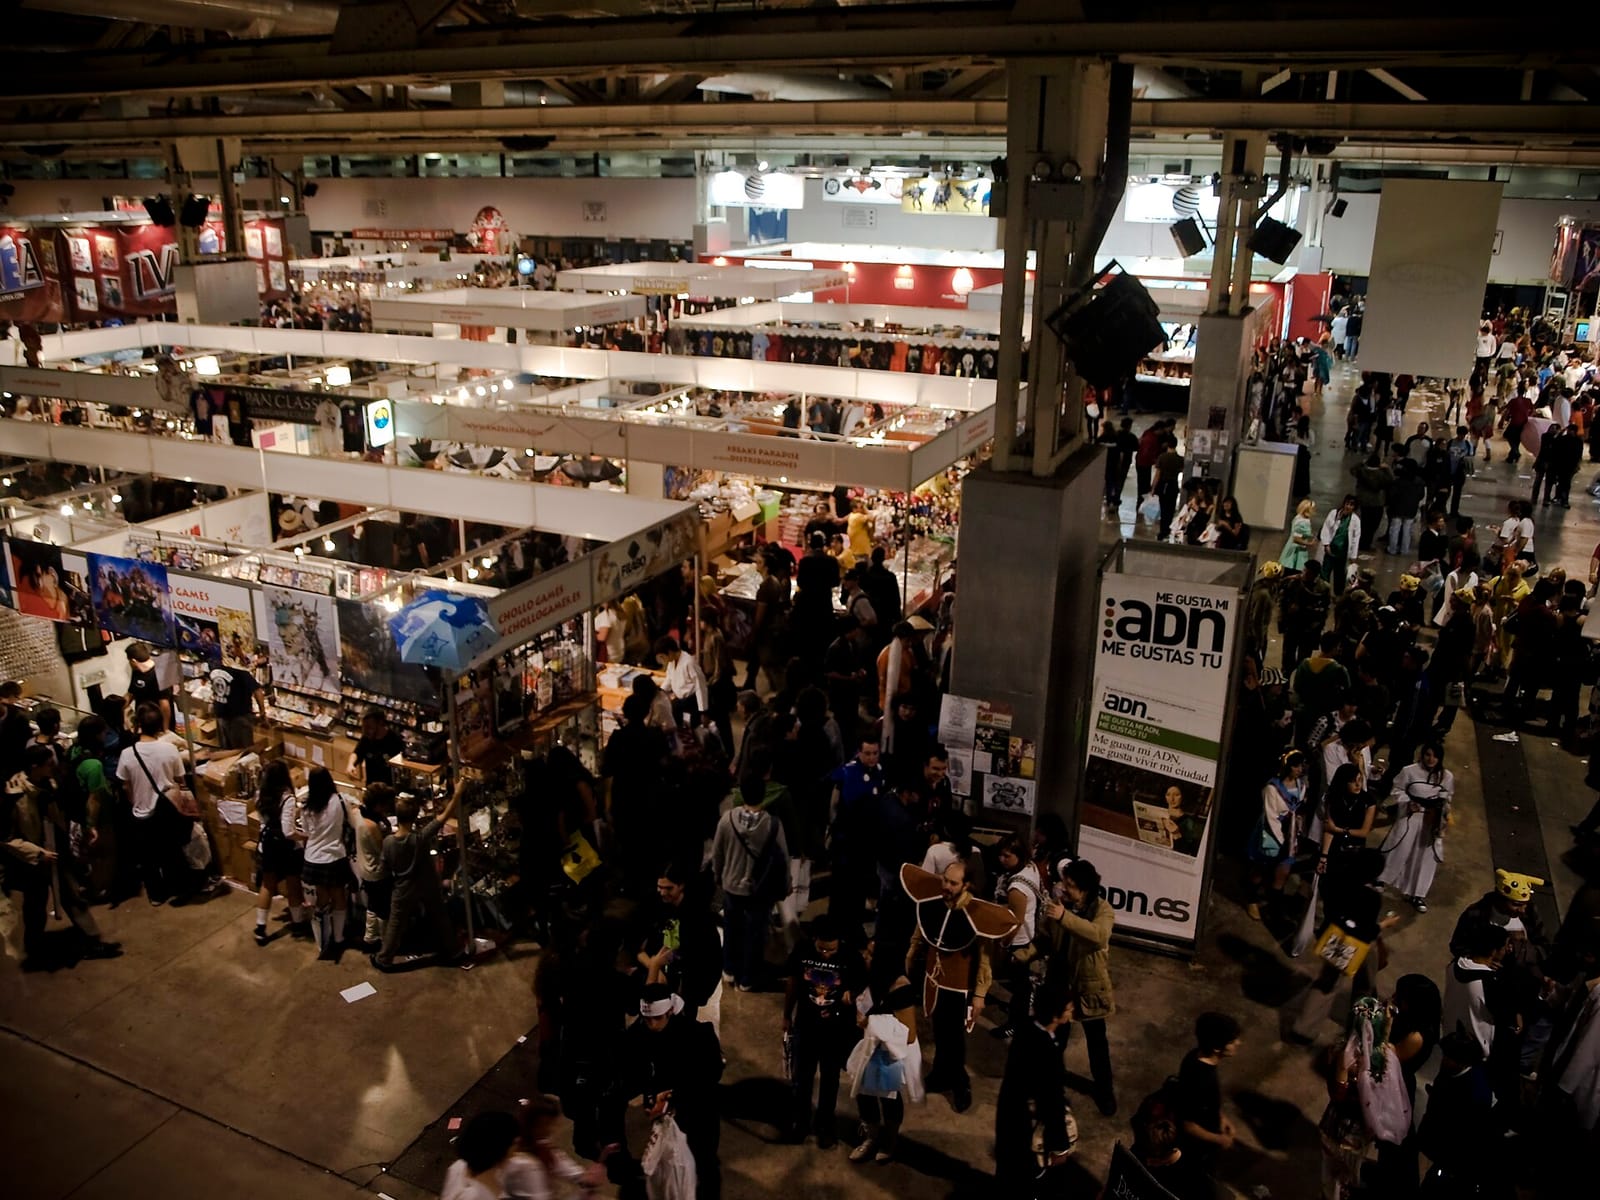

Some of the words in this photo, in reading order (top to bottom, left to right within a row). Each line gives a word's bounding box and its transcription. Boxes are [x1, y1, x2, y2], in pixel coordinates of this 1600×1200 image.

[175, 587, 210, 602] GAMES
[498, 599, 534, 625] CHOLLO
[535, 583, 565, 606] GAMES
[1155, 592, 1174, 604] ME
[1175, 594, 1213, 609] GUSTA
[1215, 599, 1229, 611] MI
[1101, 639, 1126, 656] ME
[1130, 644, 1195, 666] GUSTAS
[1199, 652, 1222, 669] TU
[1098, 720, 1109, 729] ME
[1110, 723, 1137, 737] GUSTAS
[1137, 730, 1149, 740] TU
[1100, 713, 1110, 722] ME
[1111, 714, 1134, 729] GUSTA
[1093, 733, 1109, 746] Me
[1110, 739, 1136, 753] gusta
[1137, 745, 1151, 757] mi
[1153, 750, 1182, 766] ADN,
[1090, 744, 1106, 755] me
[1107, 748, 1133, 762] gusta
[1134, 755, 1158, 769] vivir
[1159, 763, 1173, 774] mi
[1174, 766, 1210, 784] ciudad.
